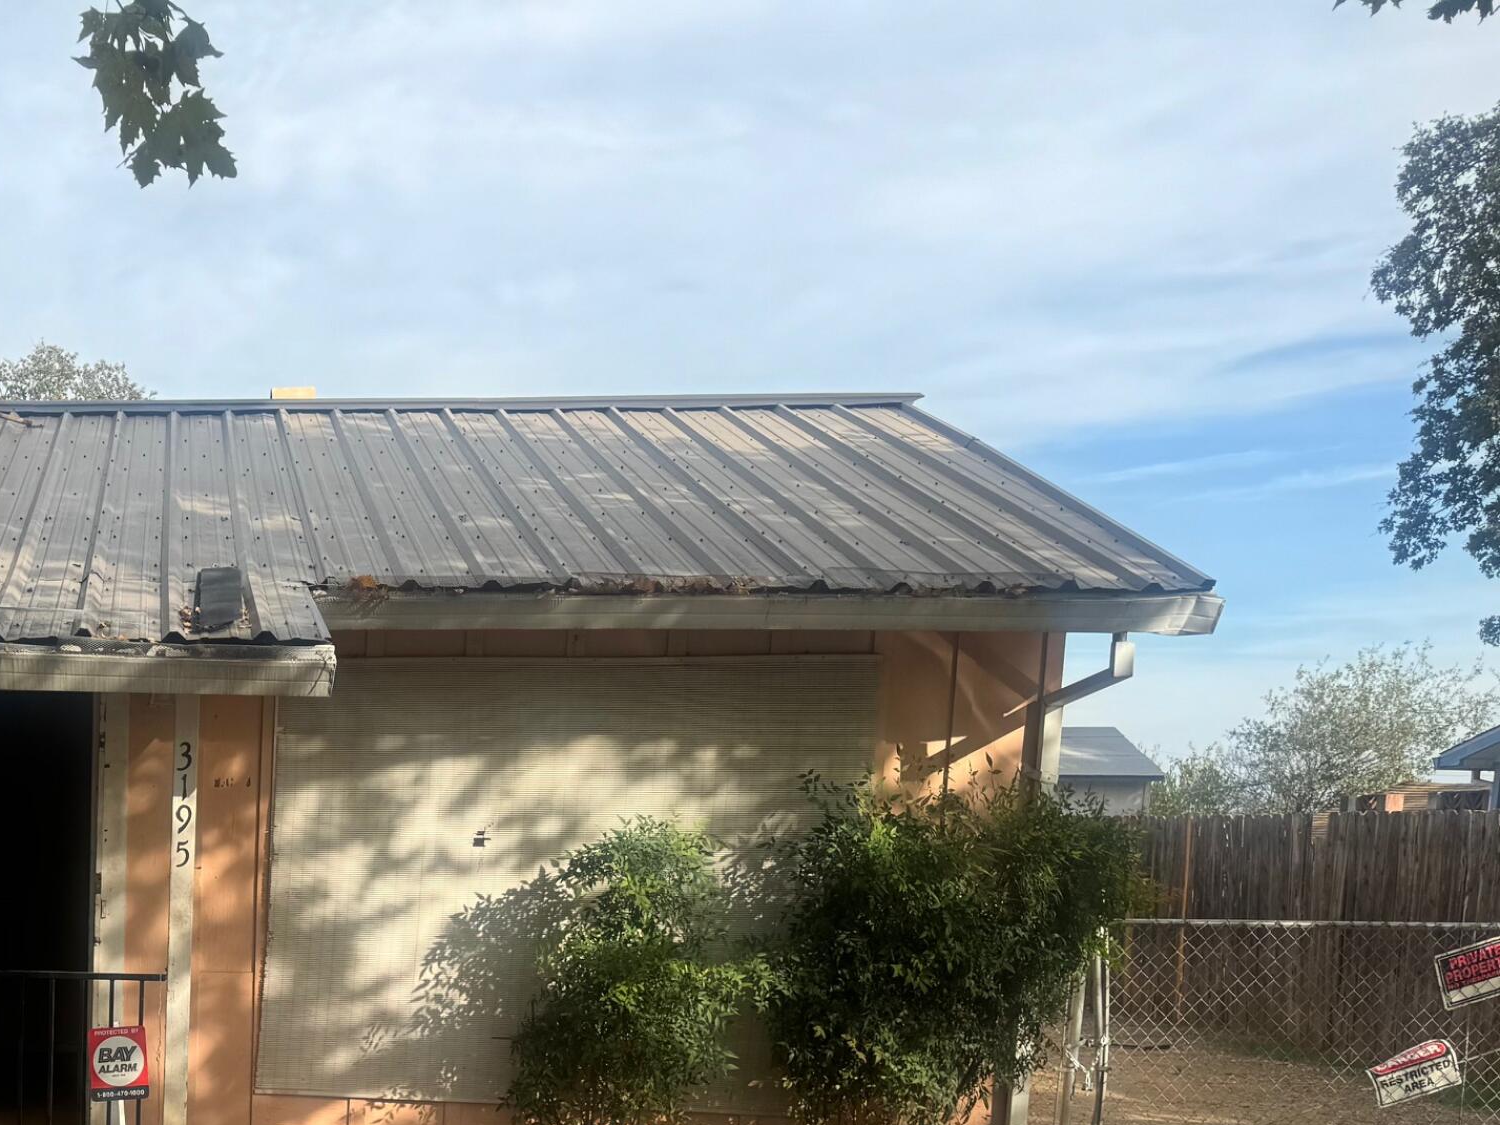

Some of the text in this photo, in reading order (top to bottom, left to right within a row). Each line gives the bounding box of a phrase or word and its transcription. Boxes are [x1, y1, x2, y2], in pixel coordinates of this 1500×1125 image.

[175, 742, 192, 867] 3195
[1449, 943, 1500, 969] PRIVATE
[98, 1046, 137, 1063] BAY
[1374, 1044, 1442, 1071] DANGER
[98, 1063, 137, 1073] ALARM
[1380, 1060, 1451, 1088] RESTRICTED
[1404, 1077, 1435, 1094] AREA
